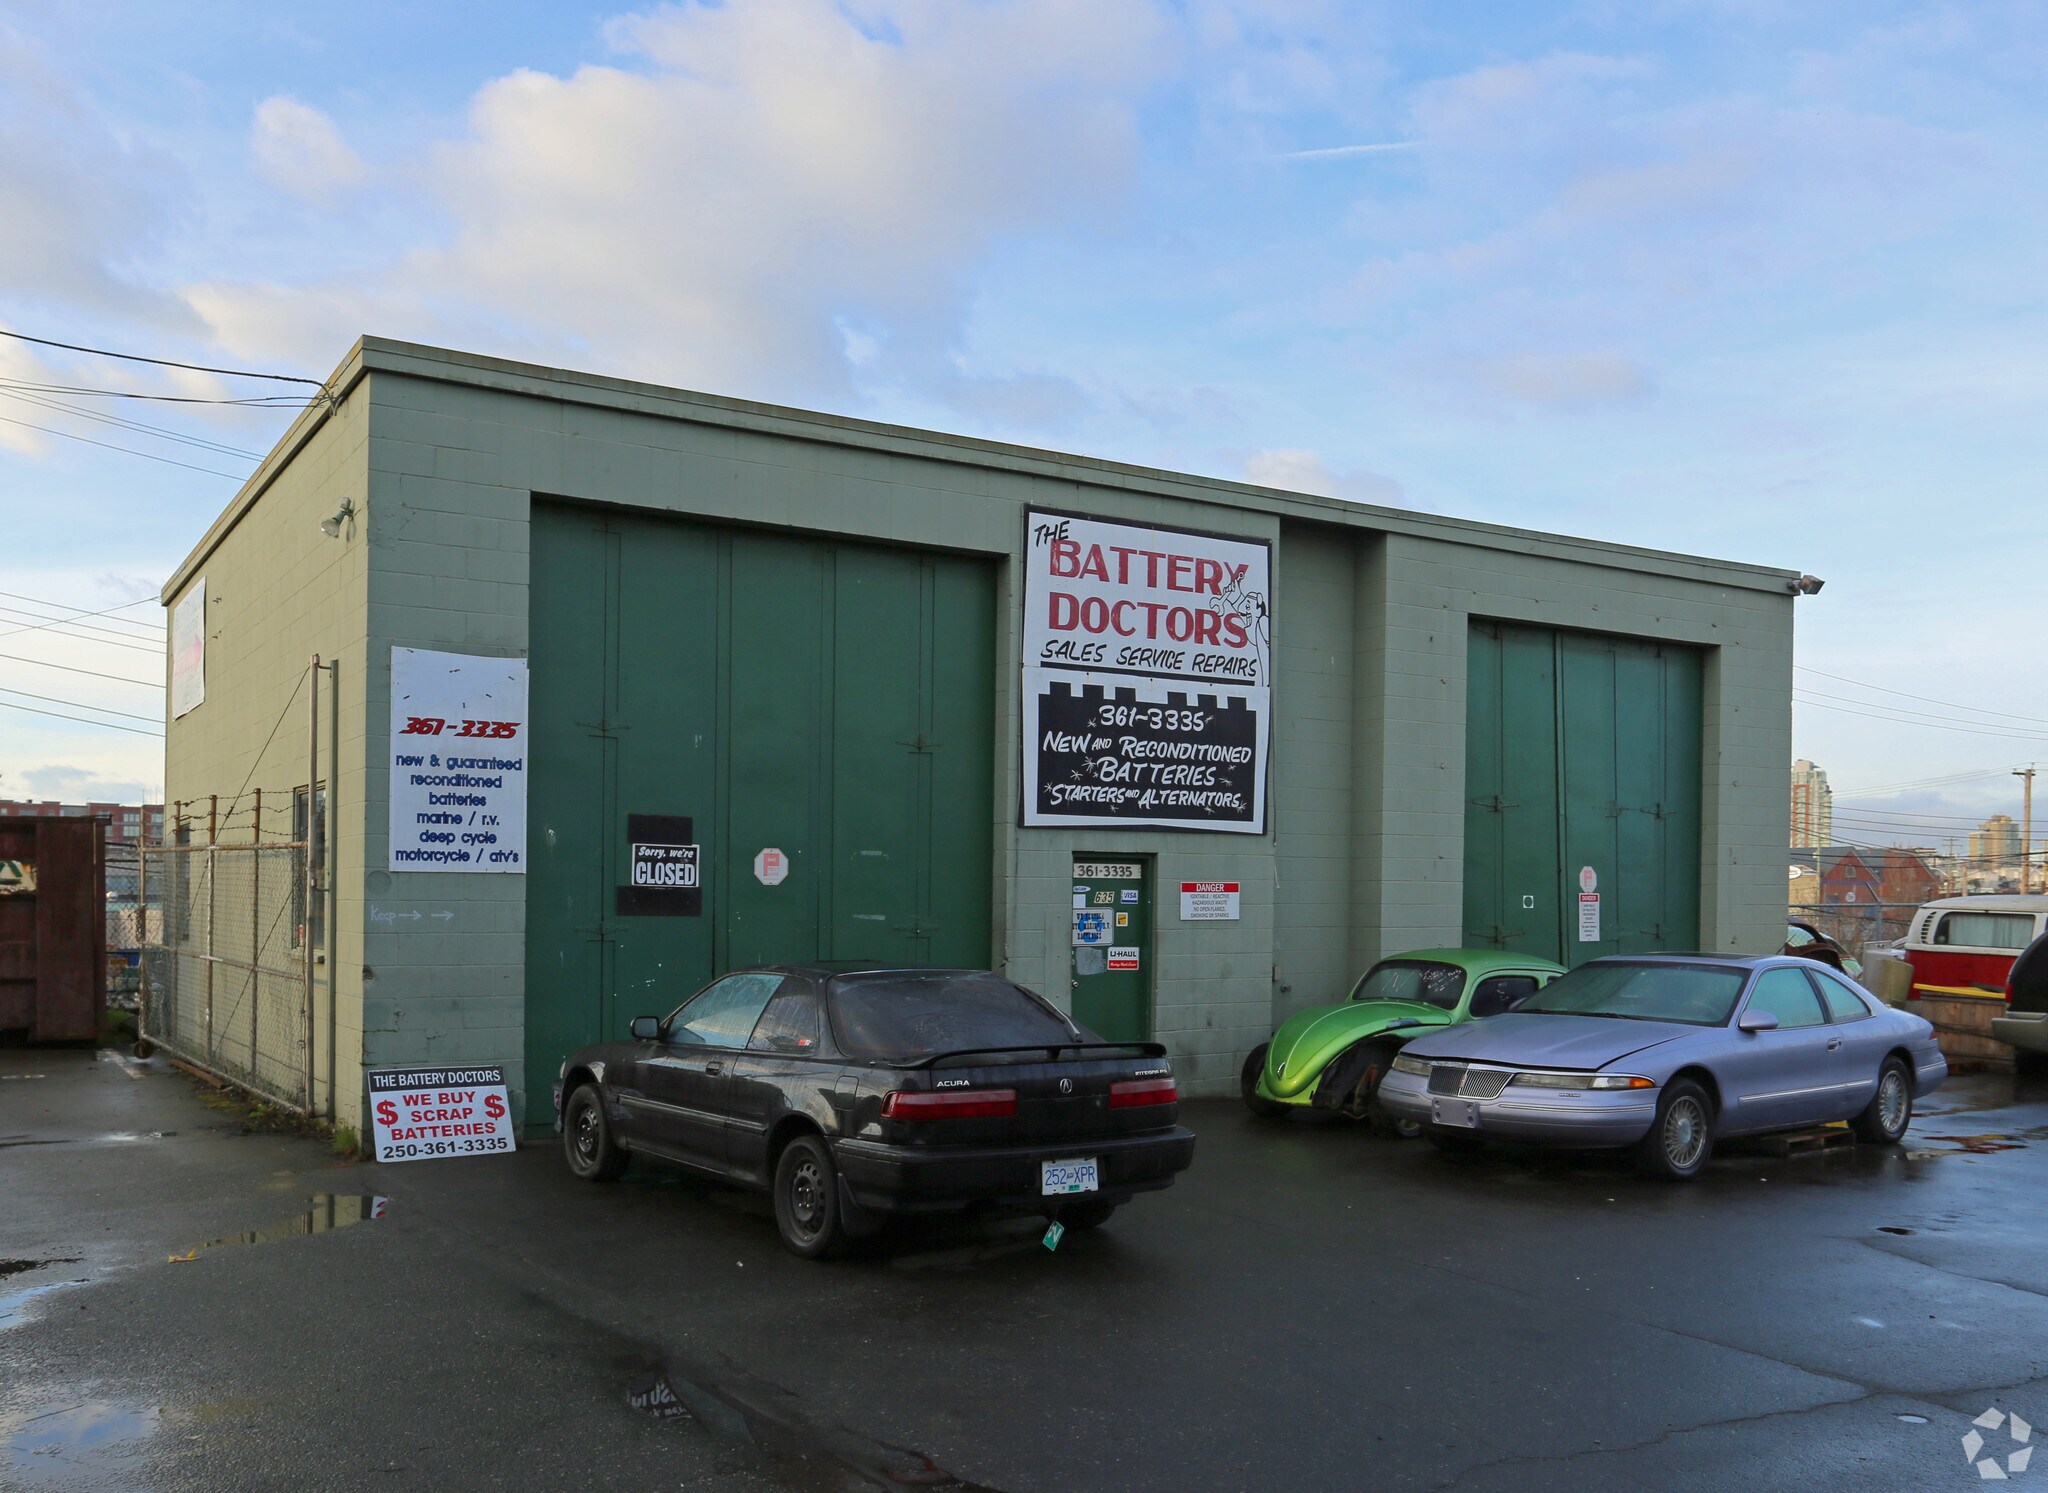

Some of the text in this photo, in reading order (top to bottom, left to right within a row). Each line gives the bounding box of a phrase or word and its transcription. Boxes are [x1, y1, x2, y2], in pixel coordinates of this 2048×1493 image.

[1034, 520, 1070, 547] THE
[1050, 539, 1249, 595] BATTERY
[1049, 591, 1248, 649] DOCTORS
[1040, 639, 1257, 677] SALES SERVICE REPAIRS
[1099, 705, 1205, 732] 361-3335
[399, 717, 522, 739] 361-3335
[1043, 730, 1252, 764] NEW AND RECONDITIONED
[395, 754, 522, 771] new & guaranteed
[1097, 756, 1217, 787] BATTERIES
[410, 773, 502, 788] reconditioned
[429, 792, 487, 806] batteries
[1050, 783, 1241, 810] STARTERS AND ALTERNATORS
[417, 811, 500, 826] marine / r.v.
[419, 829, 497, 846] deep cycle
[395, 848, 519, 864] motorcycle / atv's
[638, 846, 694, 859] Sorry, we're
[635, 861, 695, 885] CLOSED
[1077, 865, 1133, 877] 361-3335
[1196, 883, 1225, 892] DANGER
[1095, 892, 1114, 903] 635
[1110, 950, 1137, 958] U-HAUL
[373, 1070, 501, 1088] THE BATTERY DOCTORS
[936, 1080, 970, 1088] ACURA
[402, 1091, 476, 1107] WE BUY
[484, 1093, 506, 1121] $
[376, 1099, 399, 1128] $
[411, 1107, 473, 1123] SCRAP
[391, 1122, 496, 1141] BATTERIES
[383, 1137, 508, 1159] 250-361-3335
